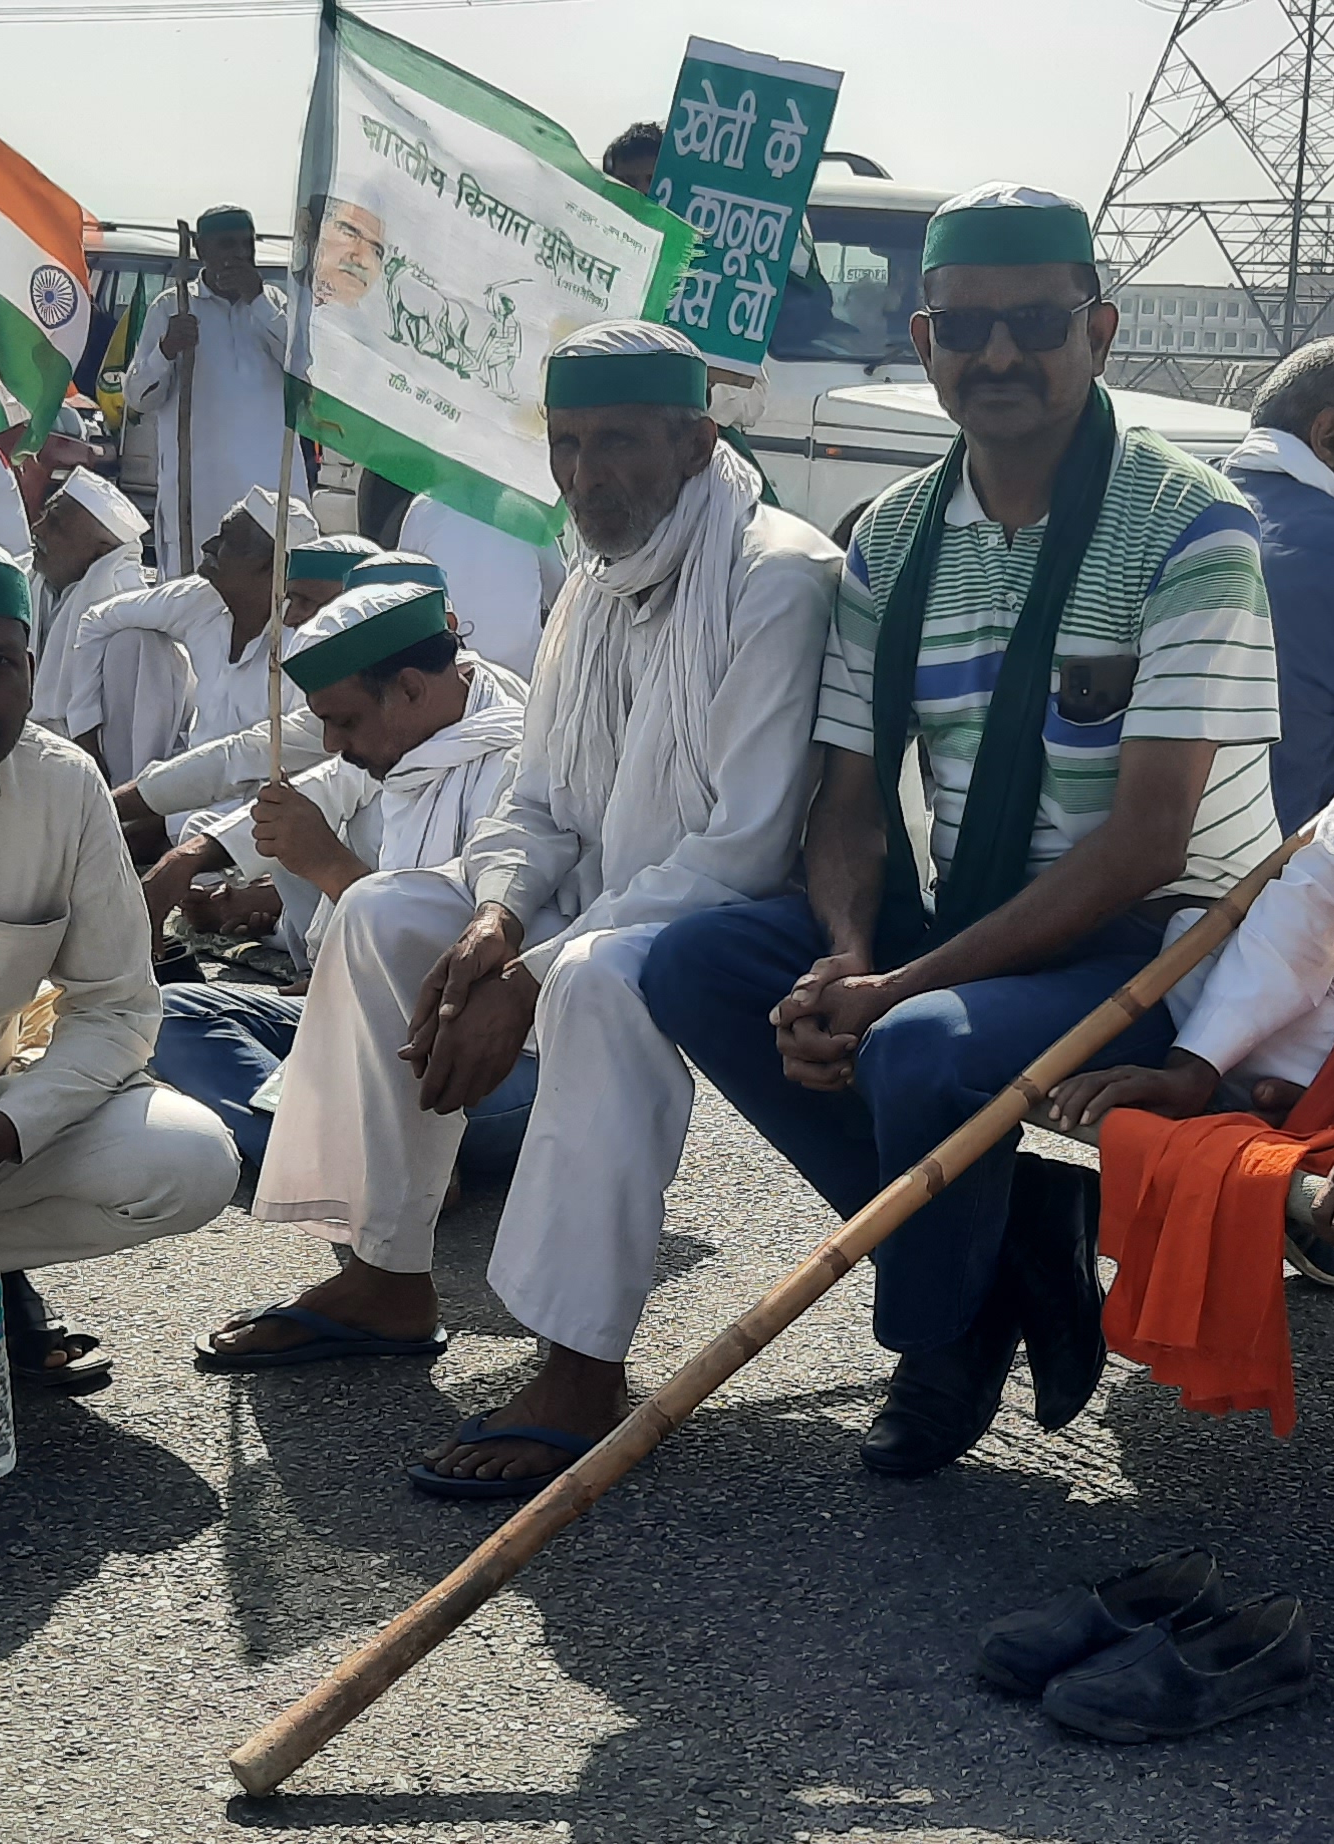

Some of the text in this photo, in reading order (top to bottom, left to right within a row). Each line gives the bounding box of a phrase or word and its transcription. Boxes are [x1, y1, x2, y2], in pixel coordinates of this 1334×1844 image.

[673, 79, 809, 179] खेती के
[360, 114, 447, 199] भारतीय
[457, 173, 536, 247] किसान
[534, 226, 621, 293] यूनियन
[685, 184, 793, 277] कानून
[727, 258, 777, 342] लो
